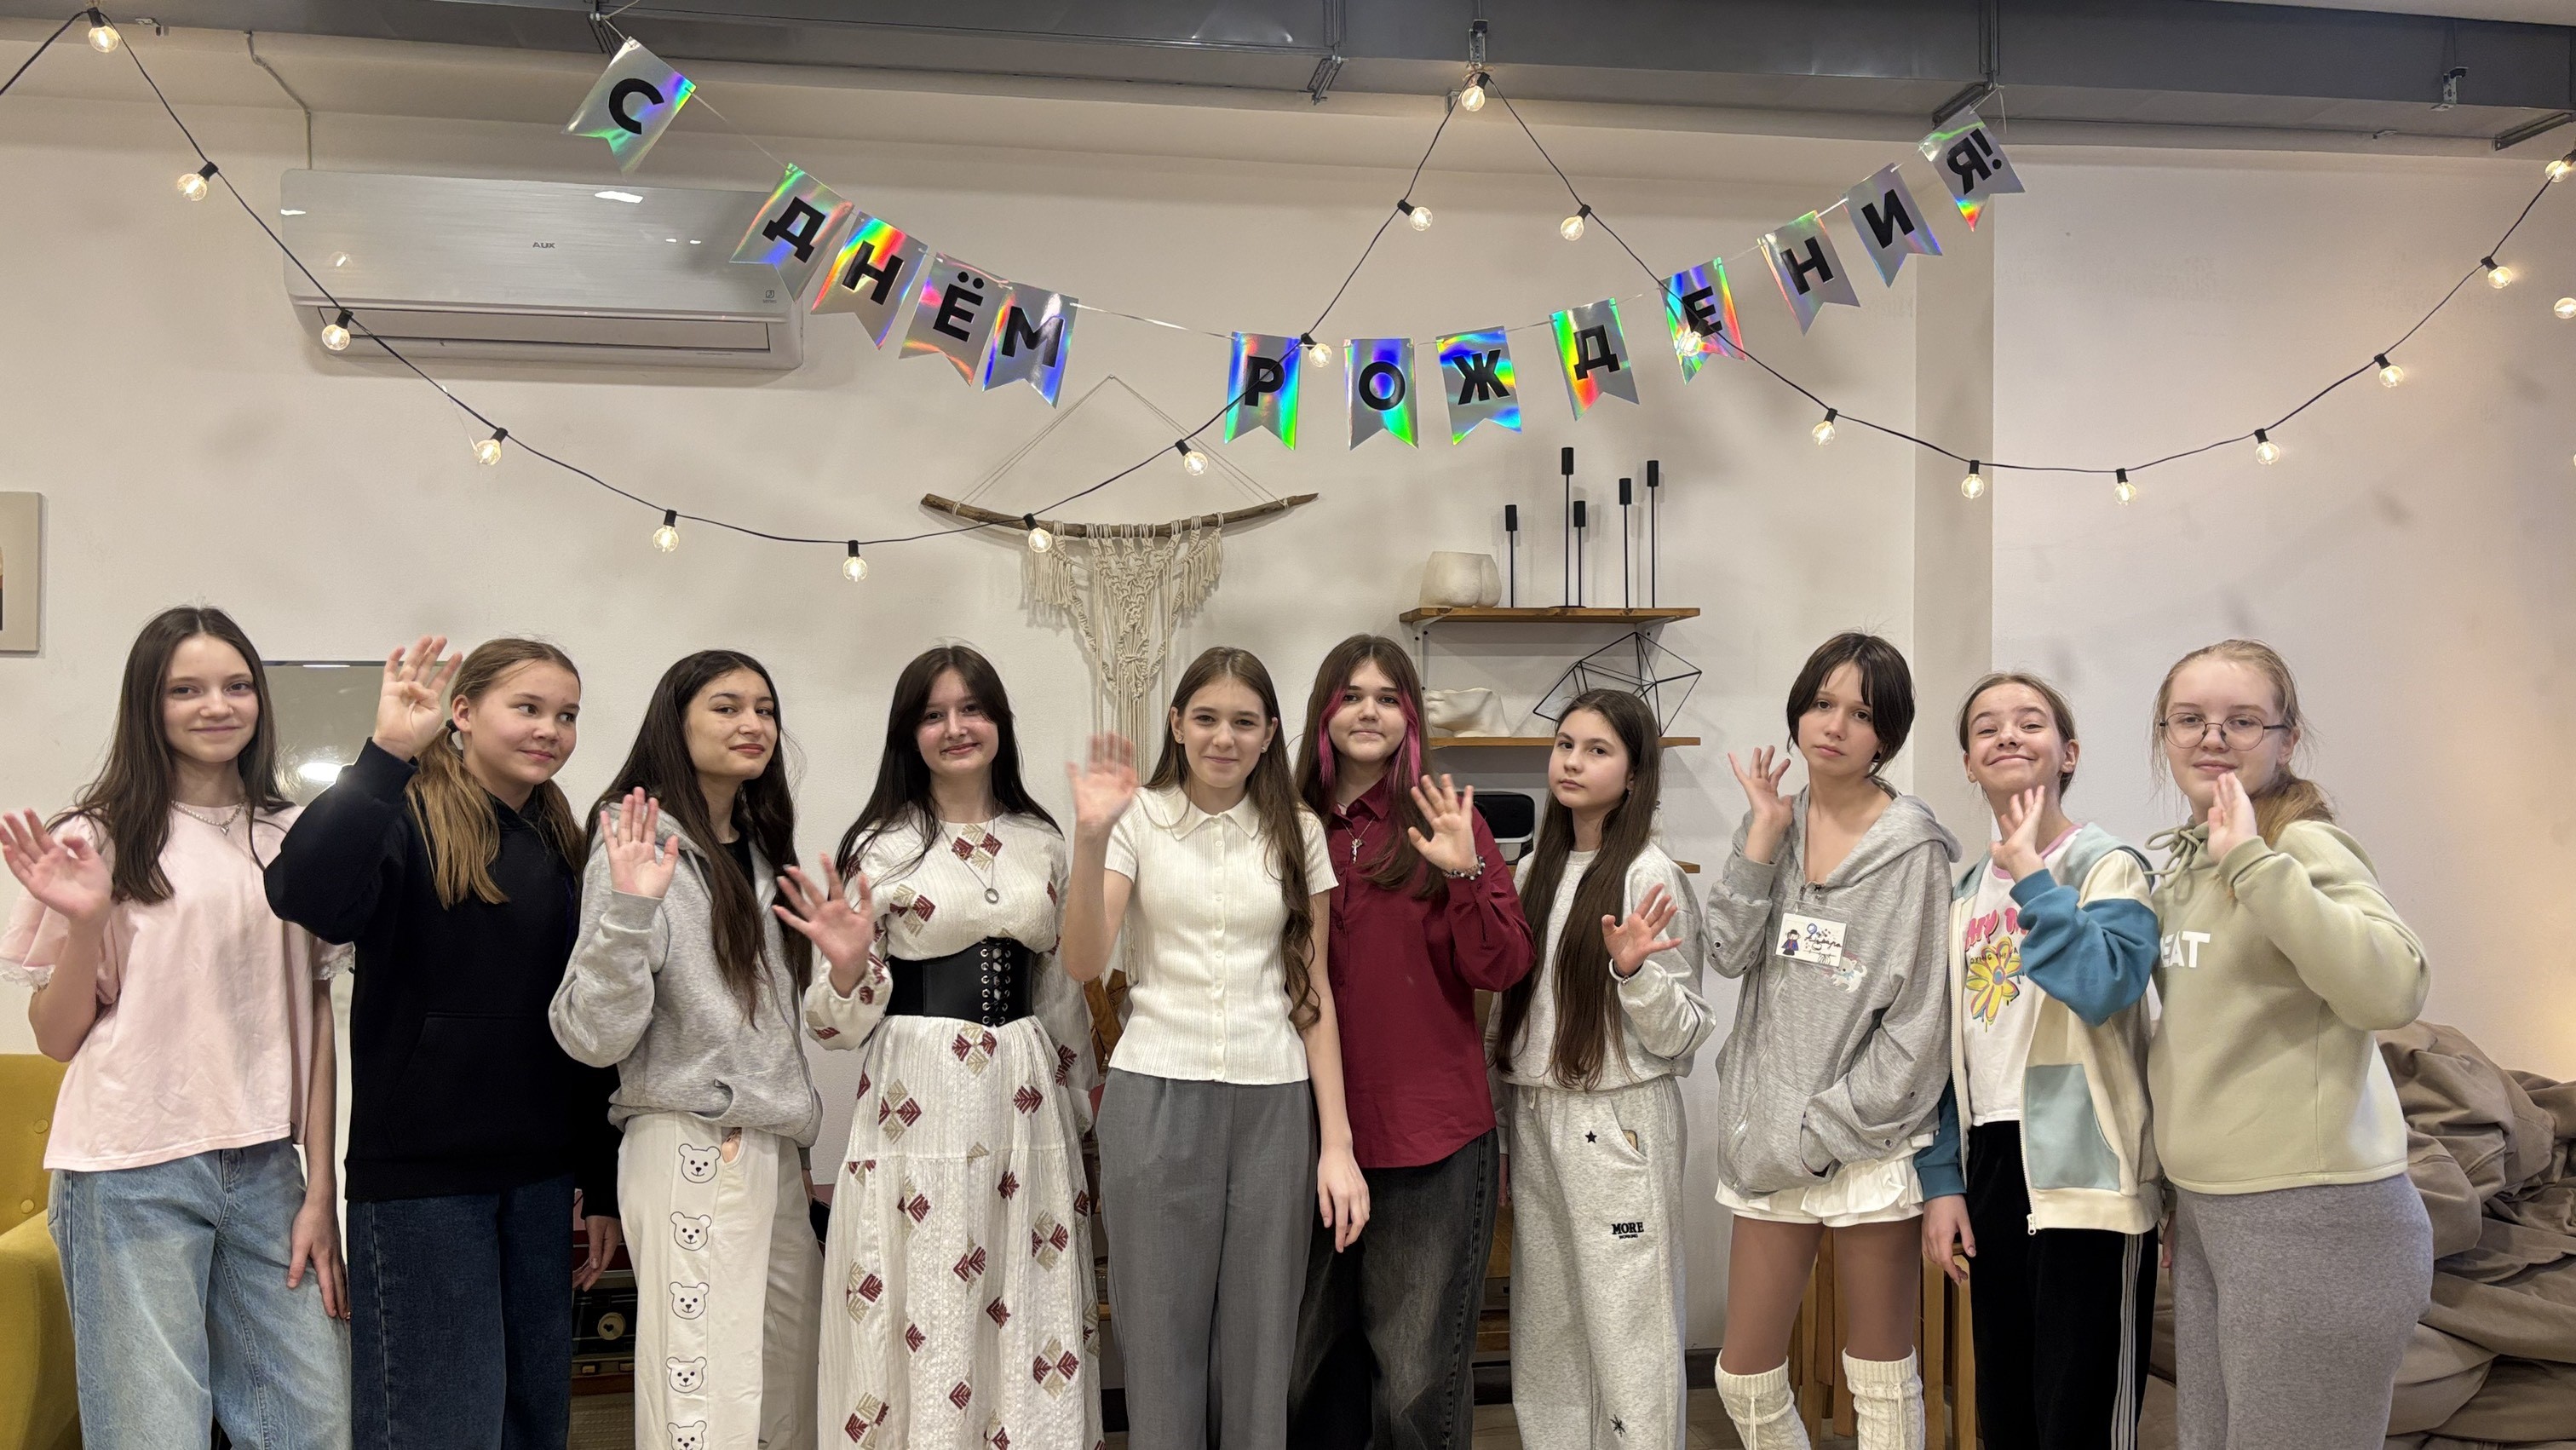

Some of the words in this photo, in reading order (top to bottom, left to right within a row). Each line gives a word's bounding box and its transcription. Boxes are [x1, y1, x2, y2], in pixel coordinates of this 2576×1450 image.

[608, 78, 664, 135] С
[762, 196, 1065, 367] ДНЁМ
[1244, 128, 2003, 411] РОЖДЕНИЯ!
[1611, 1221, 1645, 1235] MORE
